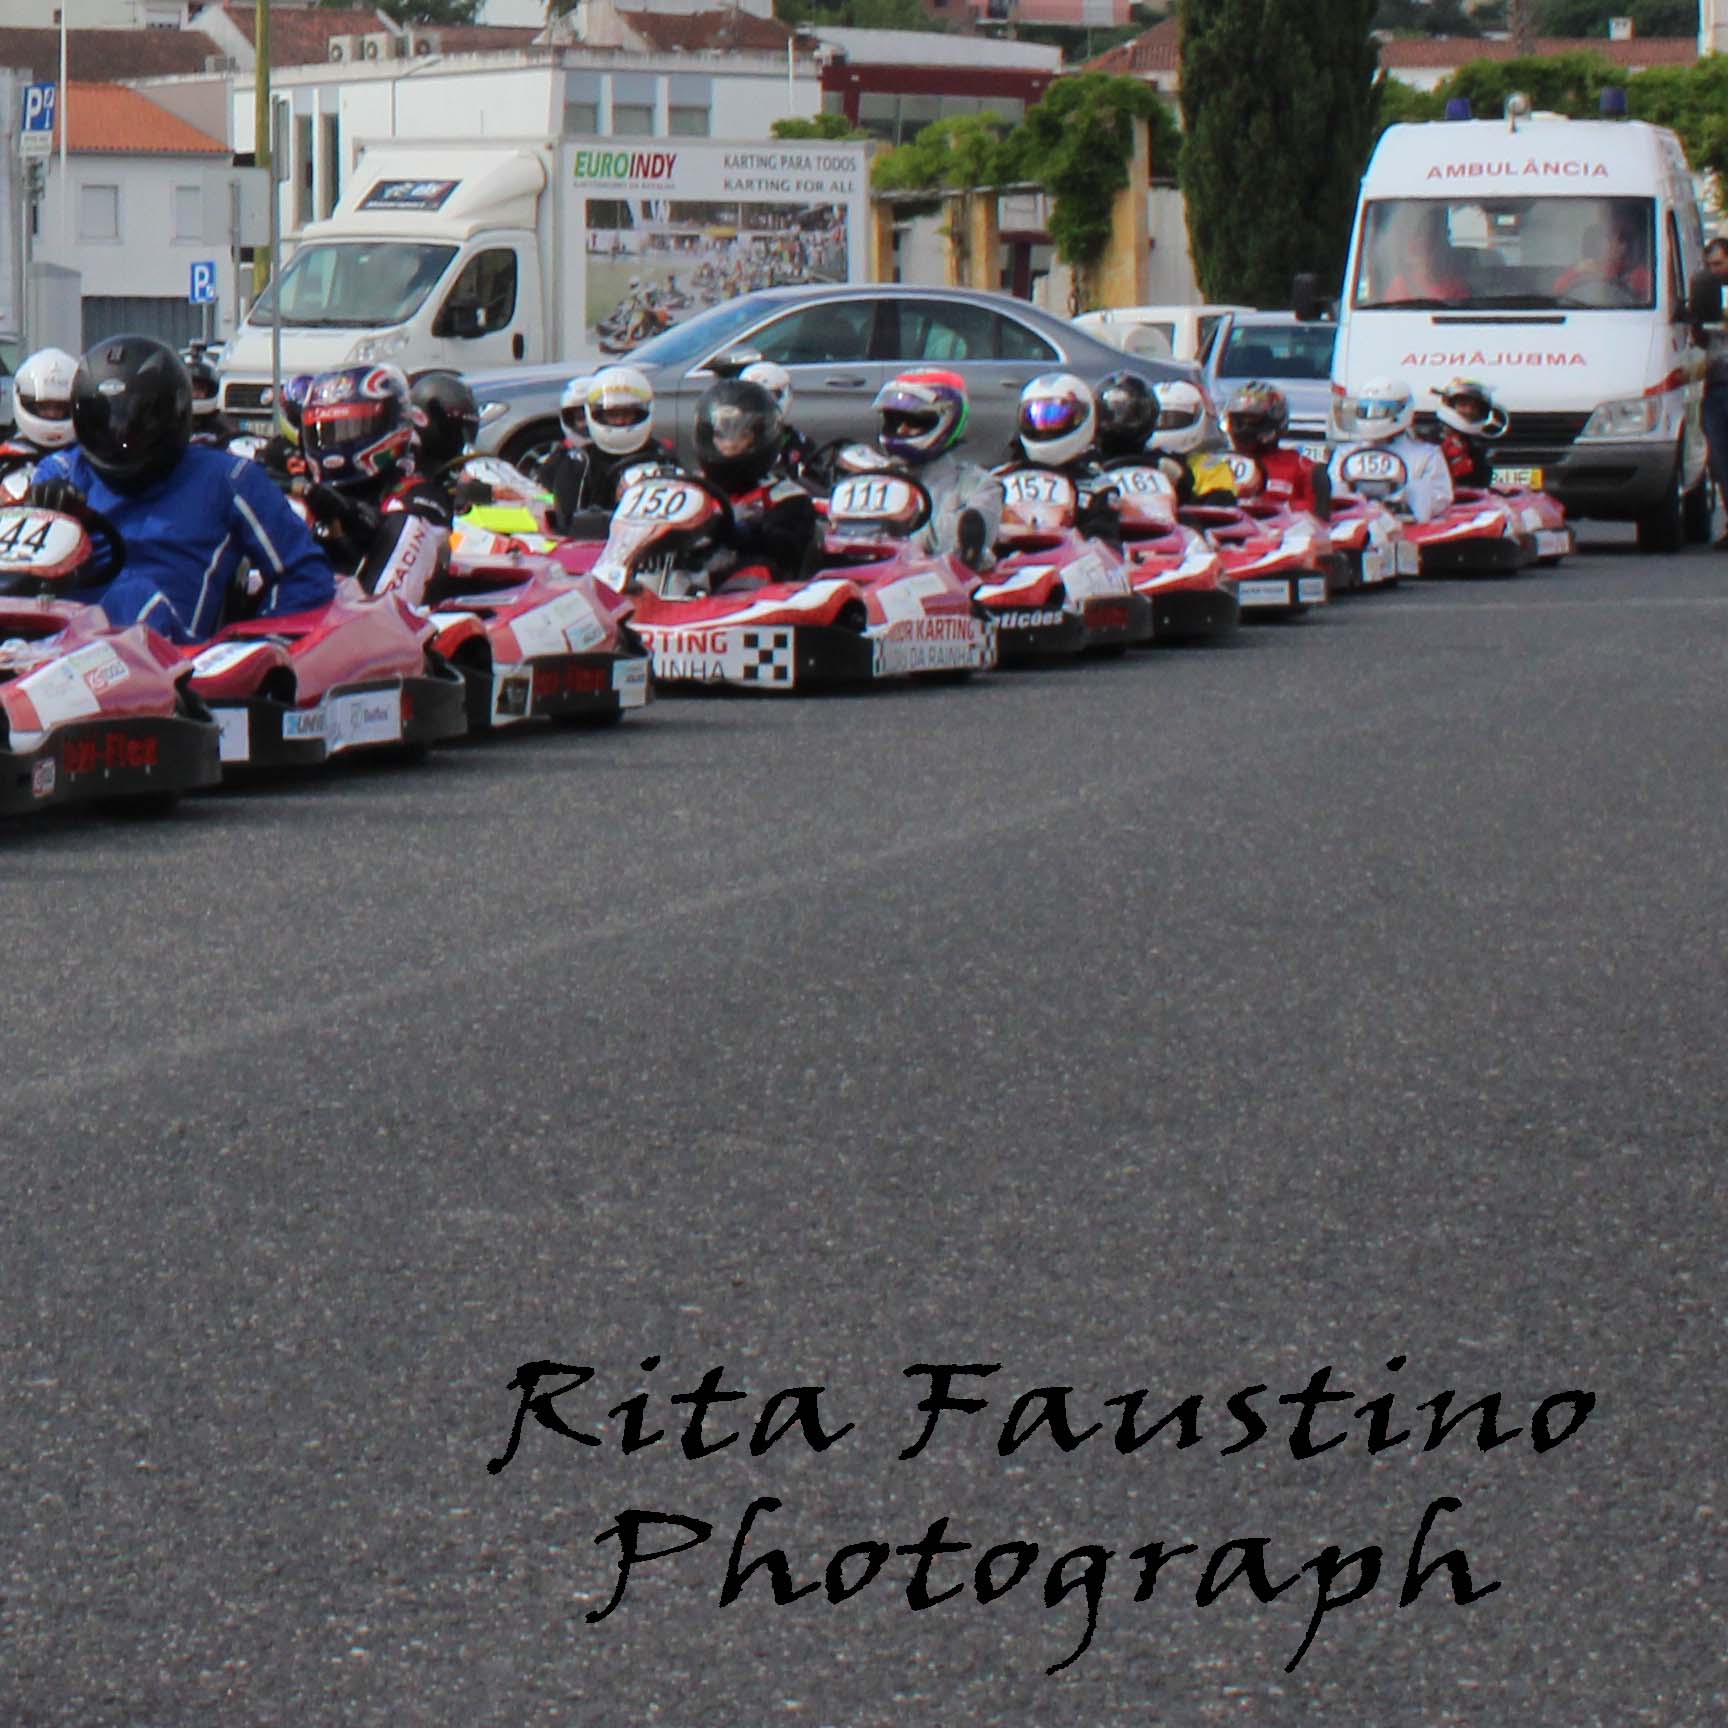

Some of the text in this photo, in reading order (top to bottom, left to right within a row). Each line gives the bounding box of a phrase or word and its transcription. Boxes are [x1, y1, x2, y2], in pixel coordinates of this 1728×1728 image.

[25, 87, 43, 130] P
[573, 151, 677, 179] EUROINDY
[724, 155, 857, 172] KARTING PARA TODOS
[1426, 157, 1609, 180] AMBULÂNCIA
[723, 176, 854, 193] KARTING FOR ALL
[194, 265, 209, 299] P
[1009, 476, 1059, 502] 157
[1117, 471, 1162, 494] 161
[626, 486, 687, 516] 150
[843, 482, 888, 511] 111
[915, 618, 976, 641] KARTING
[910, 647, 925, 666] DA
[928, 646, 974, 666] RAINHA
